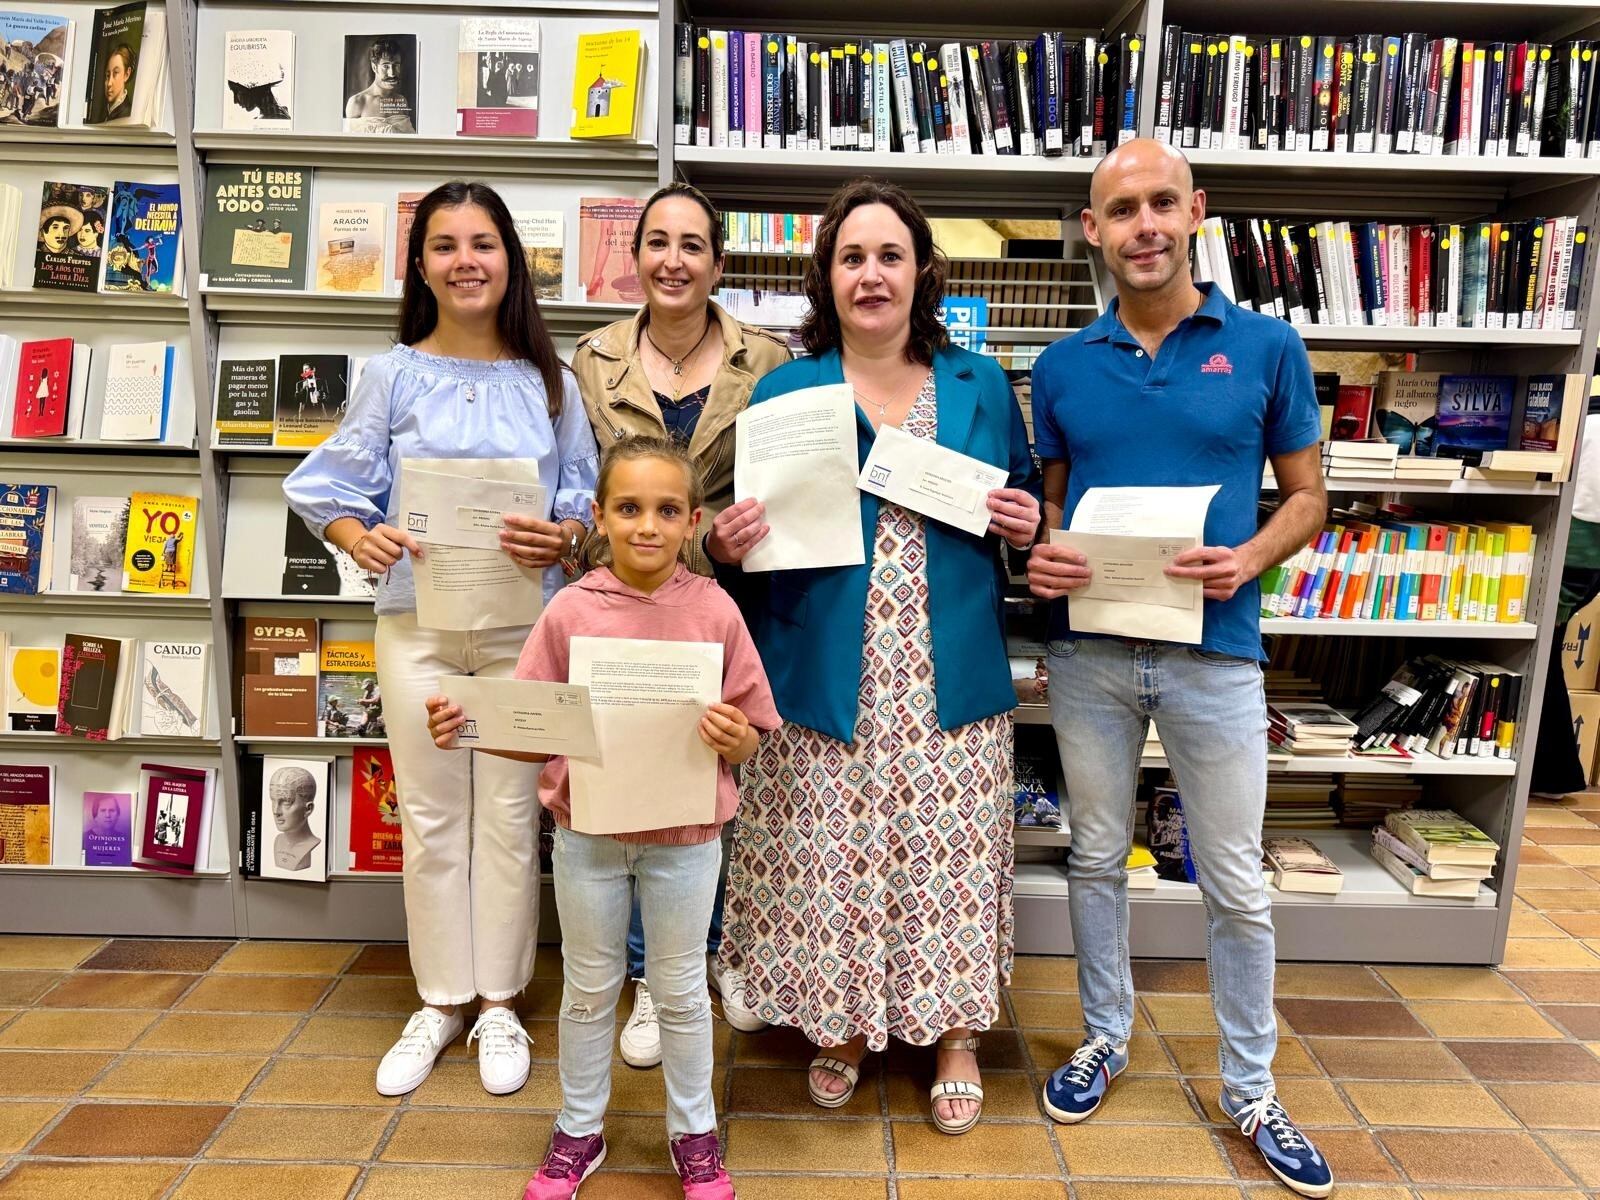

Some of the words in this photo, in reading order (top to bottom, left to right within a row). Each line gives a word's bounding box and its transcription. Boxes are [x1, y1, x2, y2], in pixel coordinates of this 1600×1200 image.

[230, 43, 268, 51] EQUILIBRISTA
[1162, 81, 1172, 99] TODO
[1160, 101, 1171, 126] MUERE
[243, 168, 262, 185] TÚ
[266, 171, 303, 185] ERES
[216, 185, 264, 198] ANTES
[268, 185, 302, 199] QUE
[217, 199, 264, 213] TODO
[333, 216, 369, 225] ARAGÓN
[232, 365, 245, 373] Más
[1396, 379, 1419, 387] María
[1420, 379, 1438, 387] Oru
[1458, 382, 1499, 393] DANIEL
[228, 391, 240, 399] por
[1395, 390, 1405, 398] El
[1394, 400, 1418, 408] negro
[1452, 393, 1502, 412] SILVA
[233, 408, 260, 416] gasolina
[142, 508, 181, 536] YO
[407, 515, 428, 528] bnf
[254, 626, 306, 638] GYPSA
[153, 644, 202, 656] CANIJO
[326, 650, 359, 659] TÁCTICAS
[326, 659, 371, 667] ESTRATEGIAS
